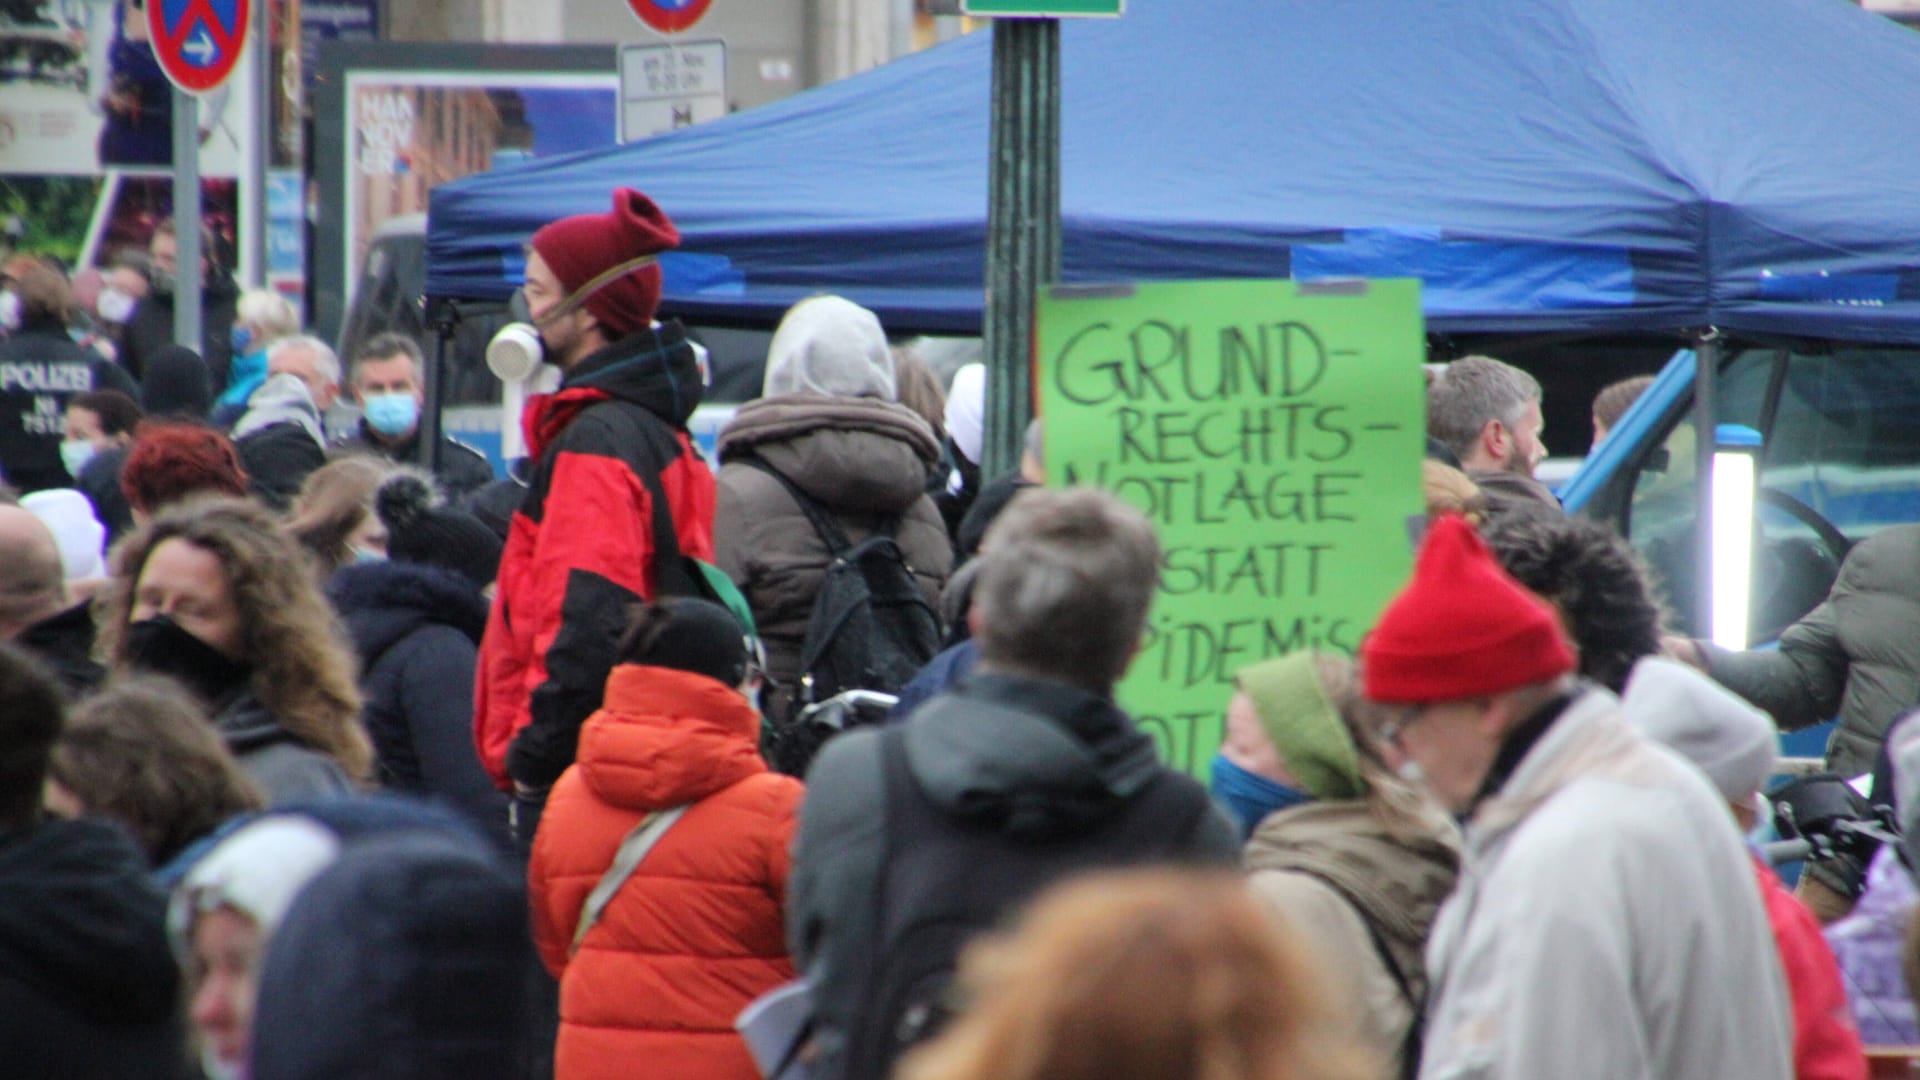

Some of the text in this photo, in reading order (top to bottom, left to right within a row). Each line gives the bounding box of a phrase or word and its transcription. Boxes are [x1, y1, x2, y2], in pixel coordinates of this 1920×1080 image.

[360, 93, 414, 121] HAN
[361, 121, 414, 148] NOV
[361, 147, 395, 174] ER
[0, 362, 92, 391] POLIZEI
[1055, 319, 1361, 406] GRUND-
[1111, 403, 1402, 464] RECHTS-
[1159, 543, 1336, 598] STATT
